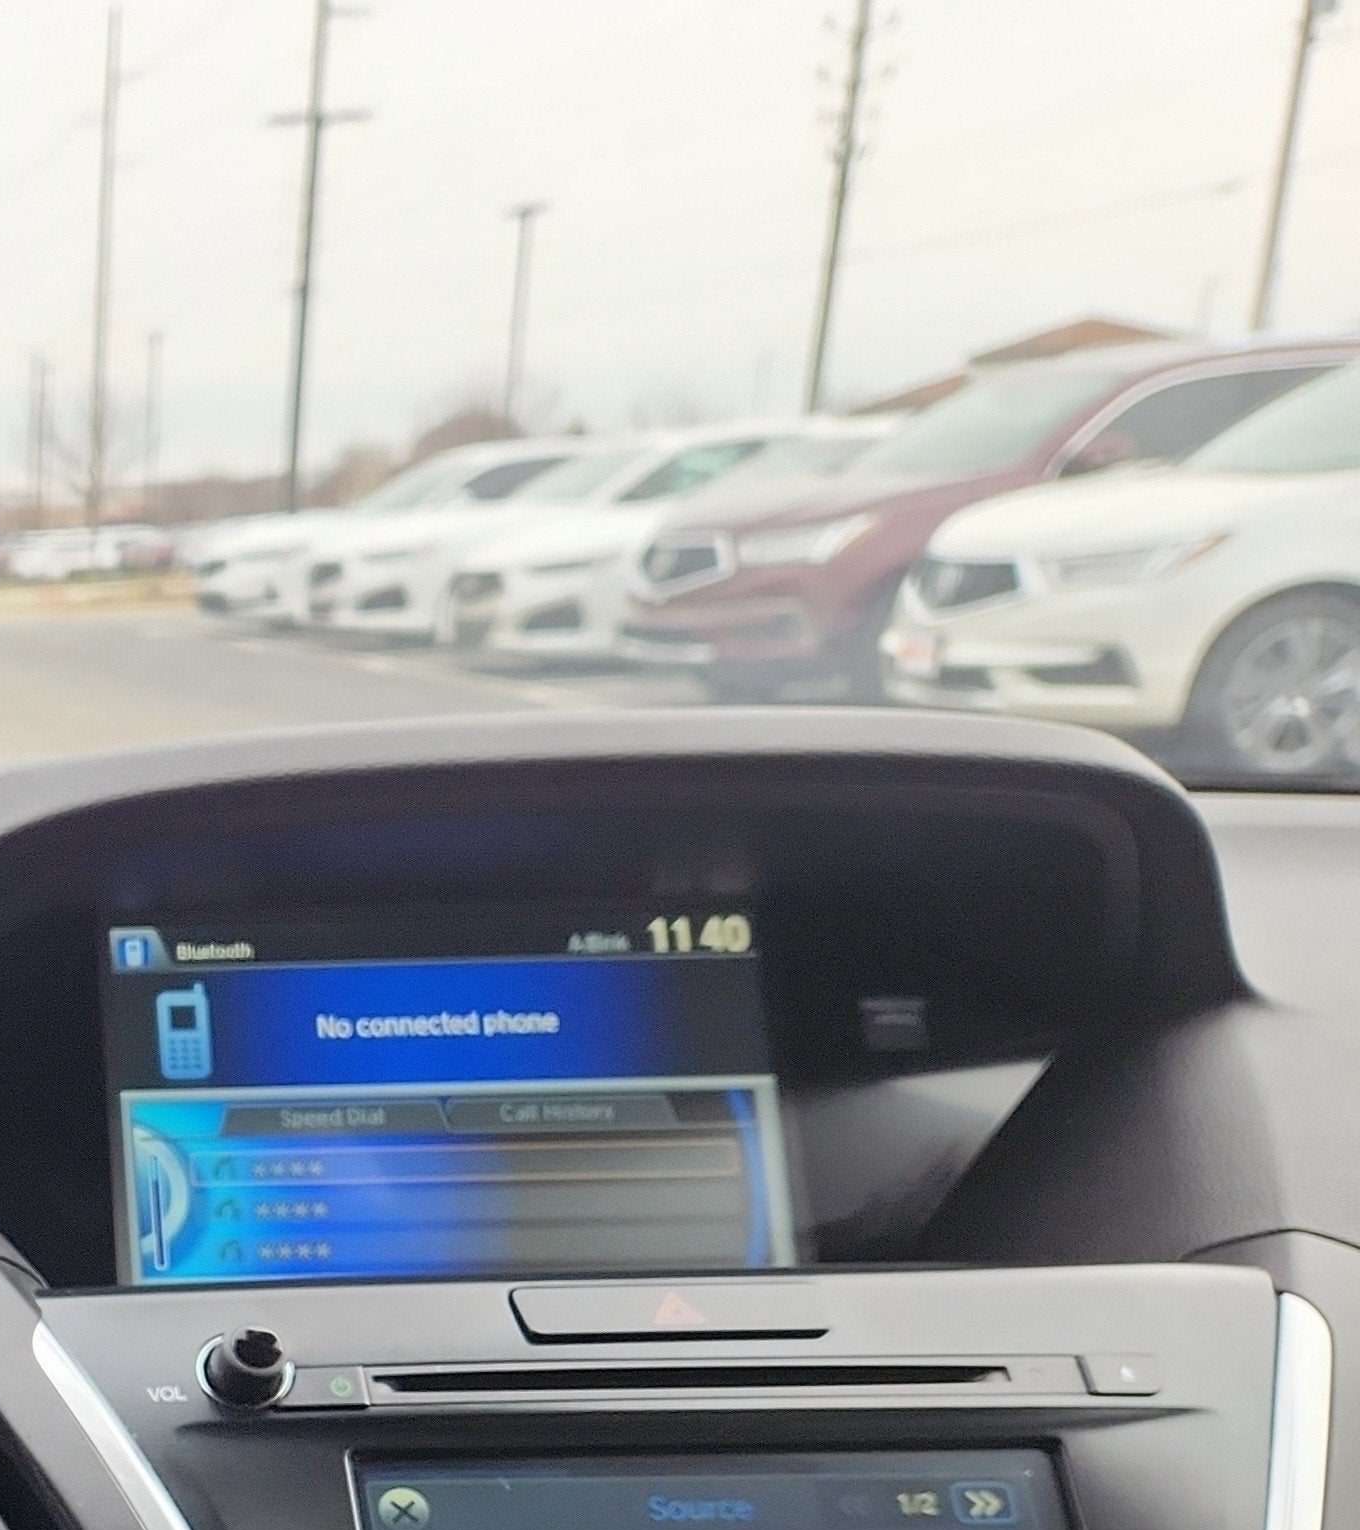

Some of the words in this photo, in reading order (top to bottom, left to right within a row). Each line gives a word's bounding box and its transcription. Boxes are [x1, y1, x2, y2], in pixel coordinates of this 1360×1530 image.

[176, 941, 255, 961] Bluetooth
[317, 1013, 350, 1039] No
[357, 1011, 479, 1037] connected
[483, 1009, 559, 1037] phone
[281, 1109, 341, 1130] Speed
[146, 1385, 188, 1402] VOL
[648, 1495, 755, 1522] Source
